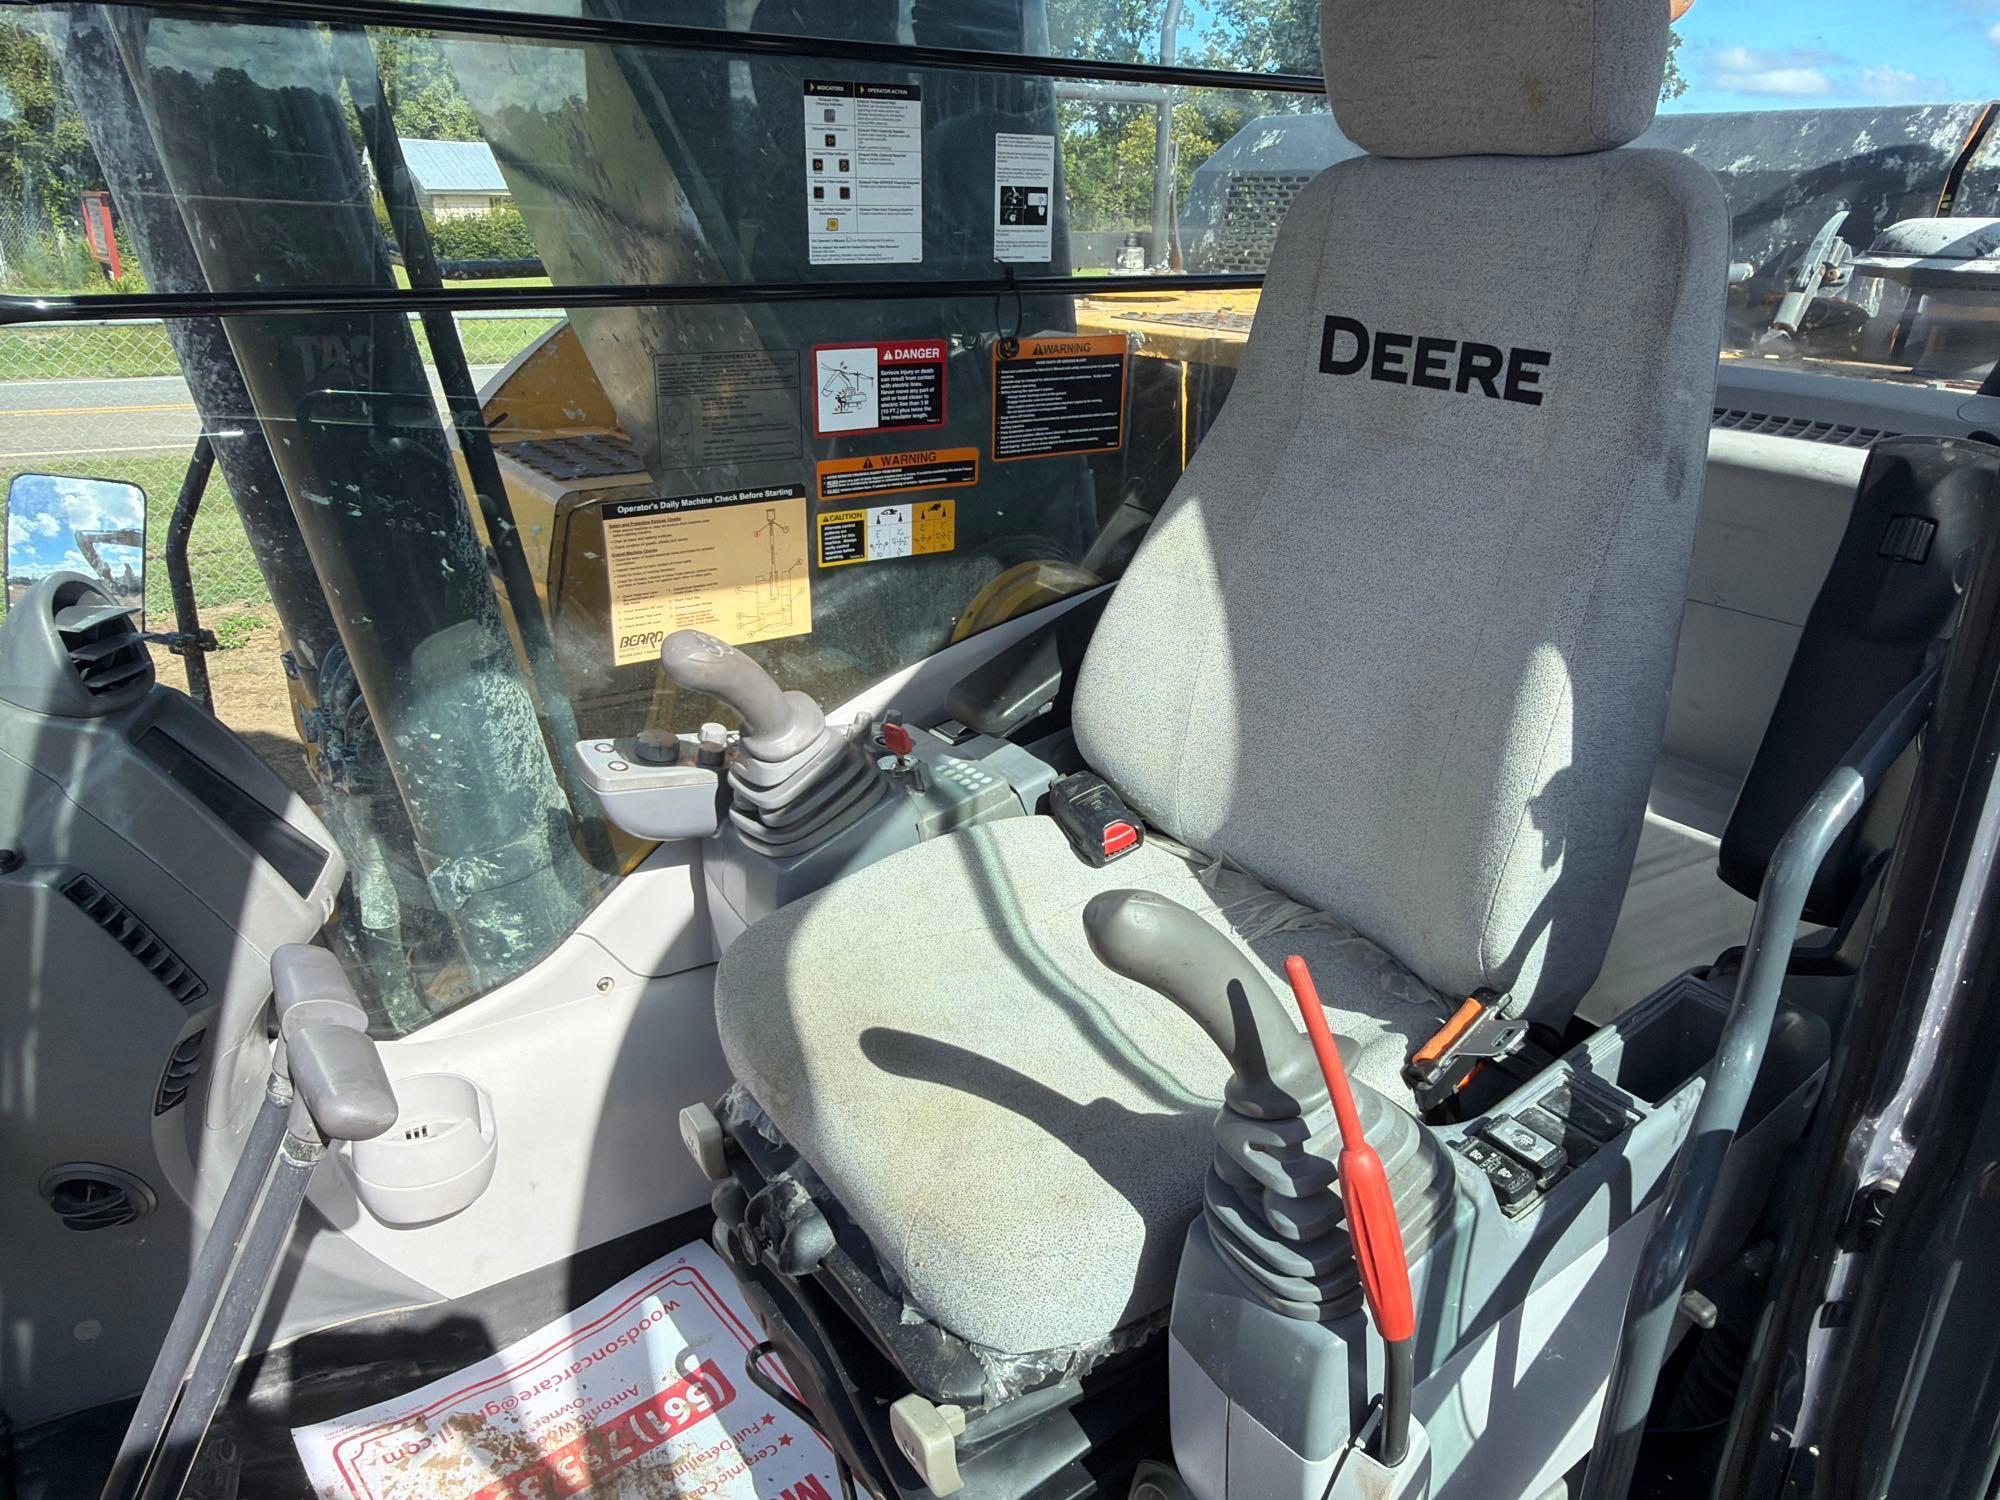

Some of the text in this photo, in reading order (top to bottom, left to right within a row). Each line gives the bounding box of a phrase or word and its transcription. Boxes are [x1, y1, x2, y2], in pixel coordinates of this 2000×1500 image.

[894, 348, 940, 359] DANGER
[1042, 343, 1091, 355] WARNING
[1319, 315, 1552, 406] DEERE
[881, 452, 937, 466] WARNING
[617, 488, 793, 514] Operator's Daily Machine Check Before Starting
[830, 512, 862, 521] CAUTION
[620, 631, 663, 648] BEARD
[381, 1299, 680, 1464] woodsoncarcare@gil.com
[576, 1384, 639, 1426] Antonio
[629, 1372, 725, 1442] (561)
[733, 1422, 760, 1444] Full
[718, 1445, 777, 1482] Ceramic
